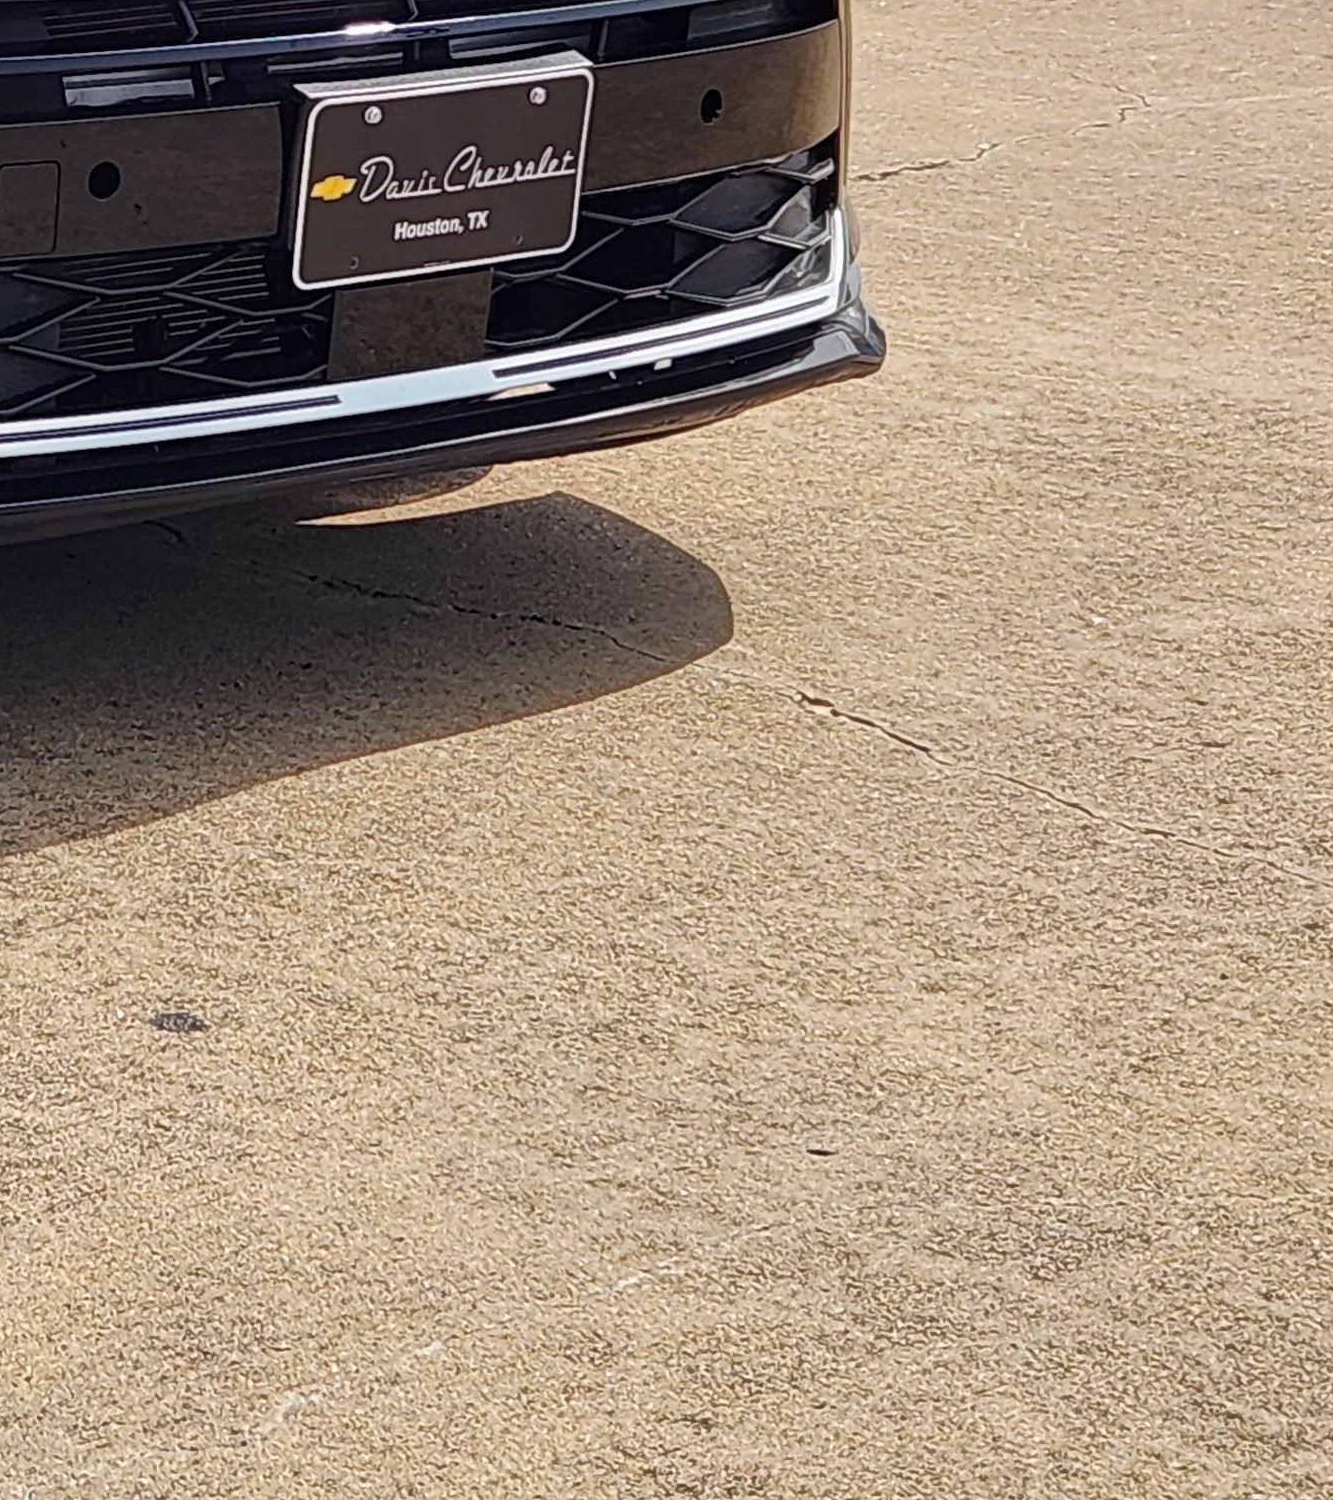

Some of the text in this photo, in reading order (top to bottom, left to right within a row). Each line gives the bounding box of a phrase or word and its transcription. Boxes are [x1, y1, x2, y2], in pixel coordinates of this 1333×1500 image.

[358, 144, 576, 202] Davis Chevrolet
[393, 210, 490, 241] Houston, TX
